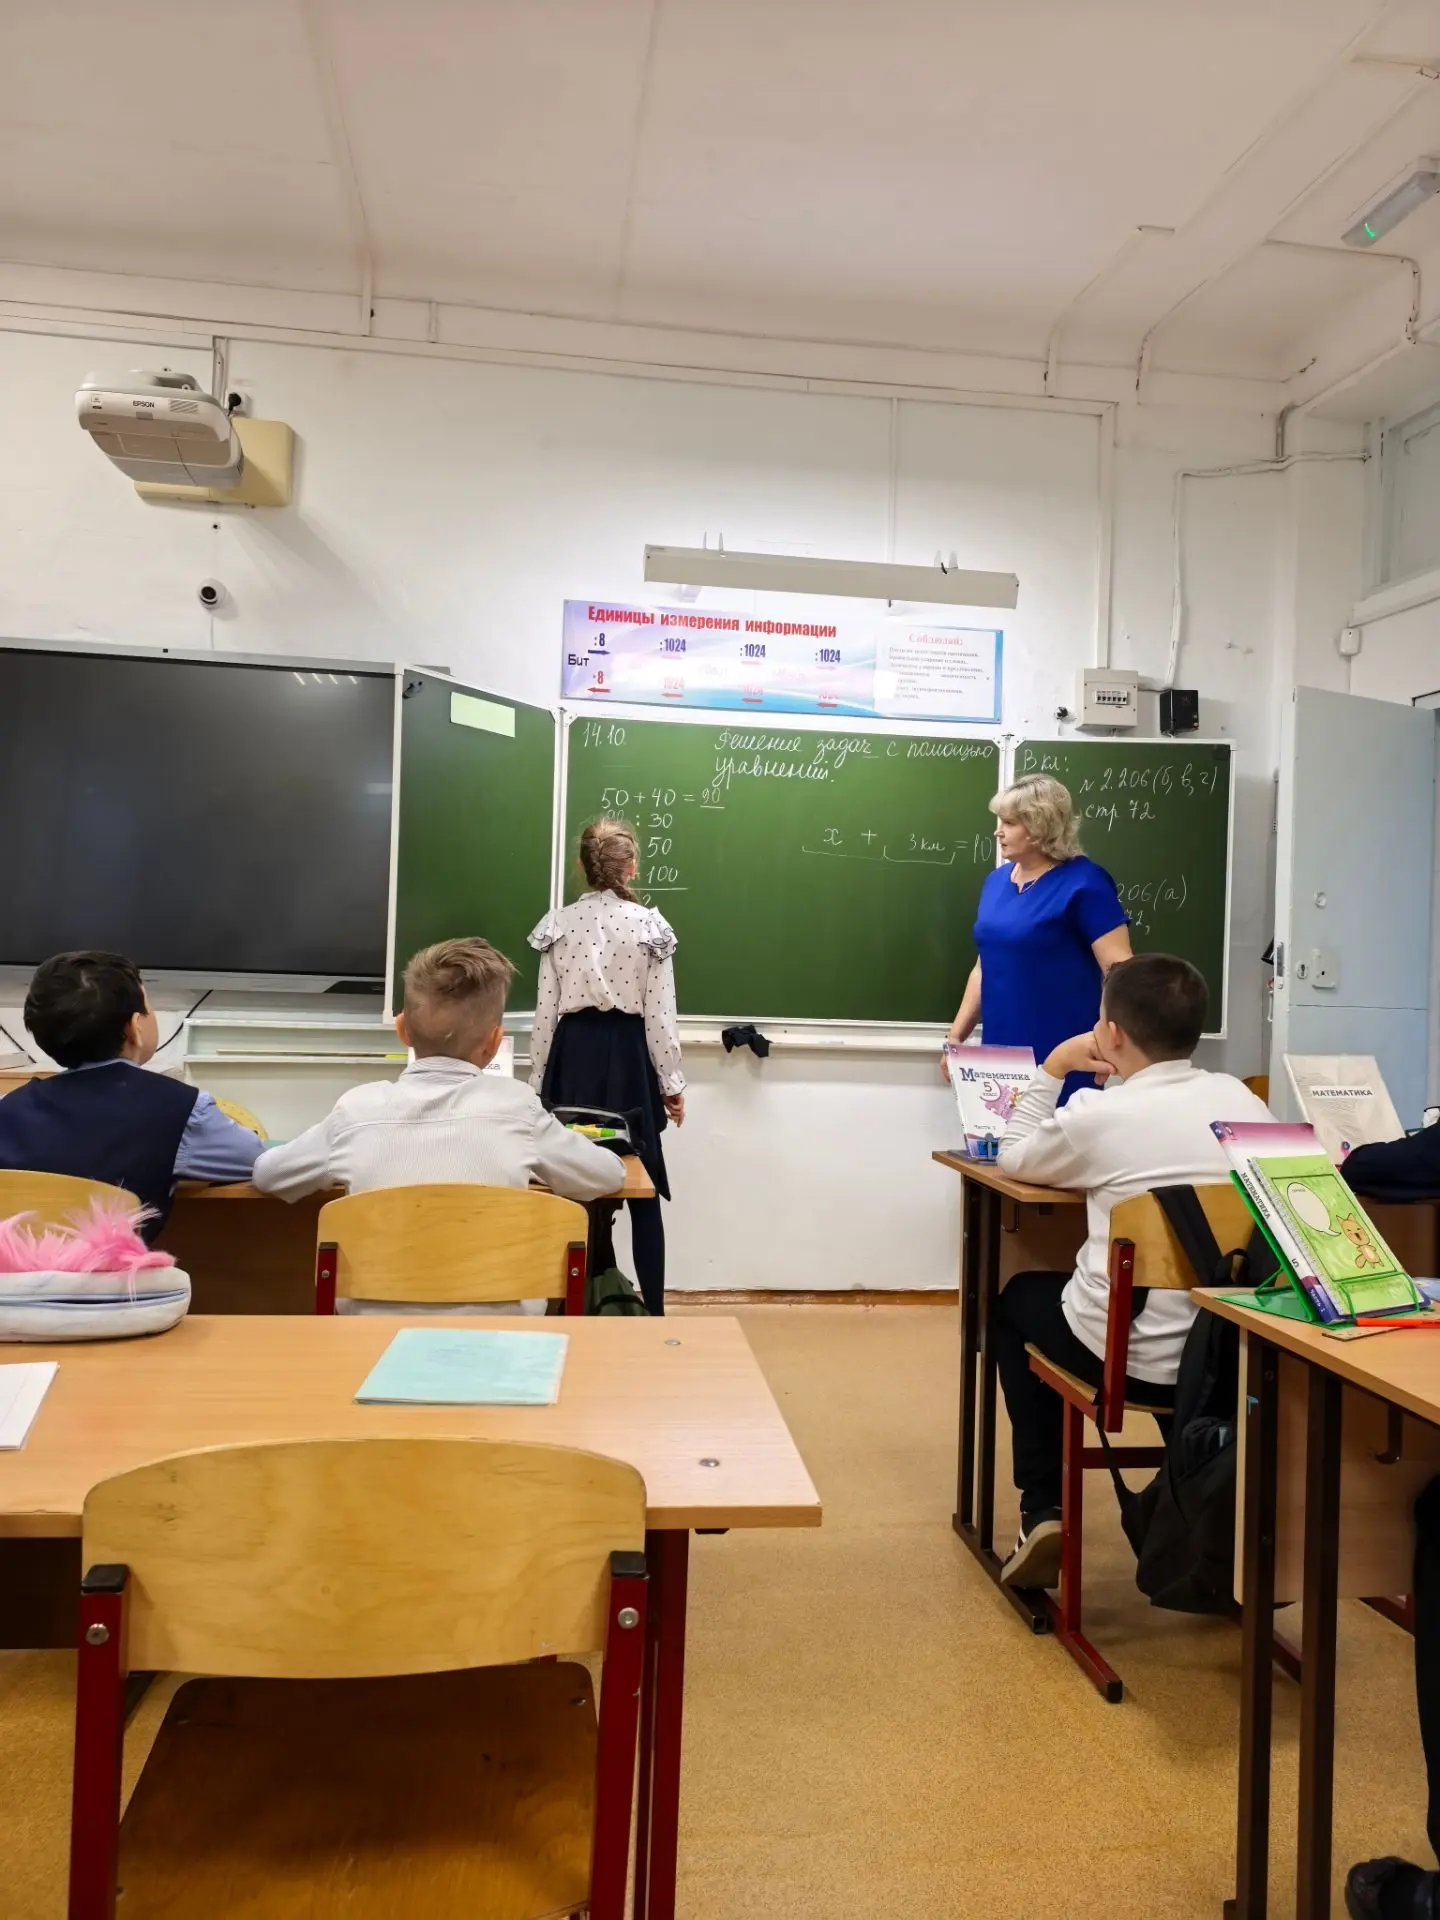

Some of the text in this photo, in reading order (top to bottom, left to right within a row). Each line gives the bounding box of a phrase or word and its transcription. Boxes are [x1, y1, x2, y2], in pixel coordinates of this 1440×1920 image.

[132, 400, 155, 408] EPSON
[588, 606, 837, 638] Единицы измерения информации
[659, 638, 687, 653] :1024
[739, 643, 766, 658] :1024
[567, 653, 589, 666] Бит
[815, 648, 841, 663] :1024
[714, 727, 994, 769] Решение задач с помощью
[601, 787, 629, 809] 50
[651, 787, 676, 808] 40
[701, 786, 721, 805] 90
[647, 812, 673, 829] 30
[1084, 799, 1156, 833] стр 72
[646, 836, 672, 858] 50
[973, 833, 993, 864] 10
[646, 865, 679, 884] 100
[959, 1066, 1031, 1082] Математика
[982, 1081, 993, 1093] 5
[1312, 1088, 1374, 1098] МАТЕМАТИКА
[1240, 1172, 1272, 1220] МАТЕМАТИКА
[1291, 1258, 1300, 1268] 5
